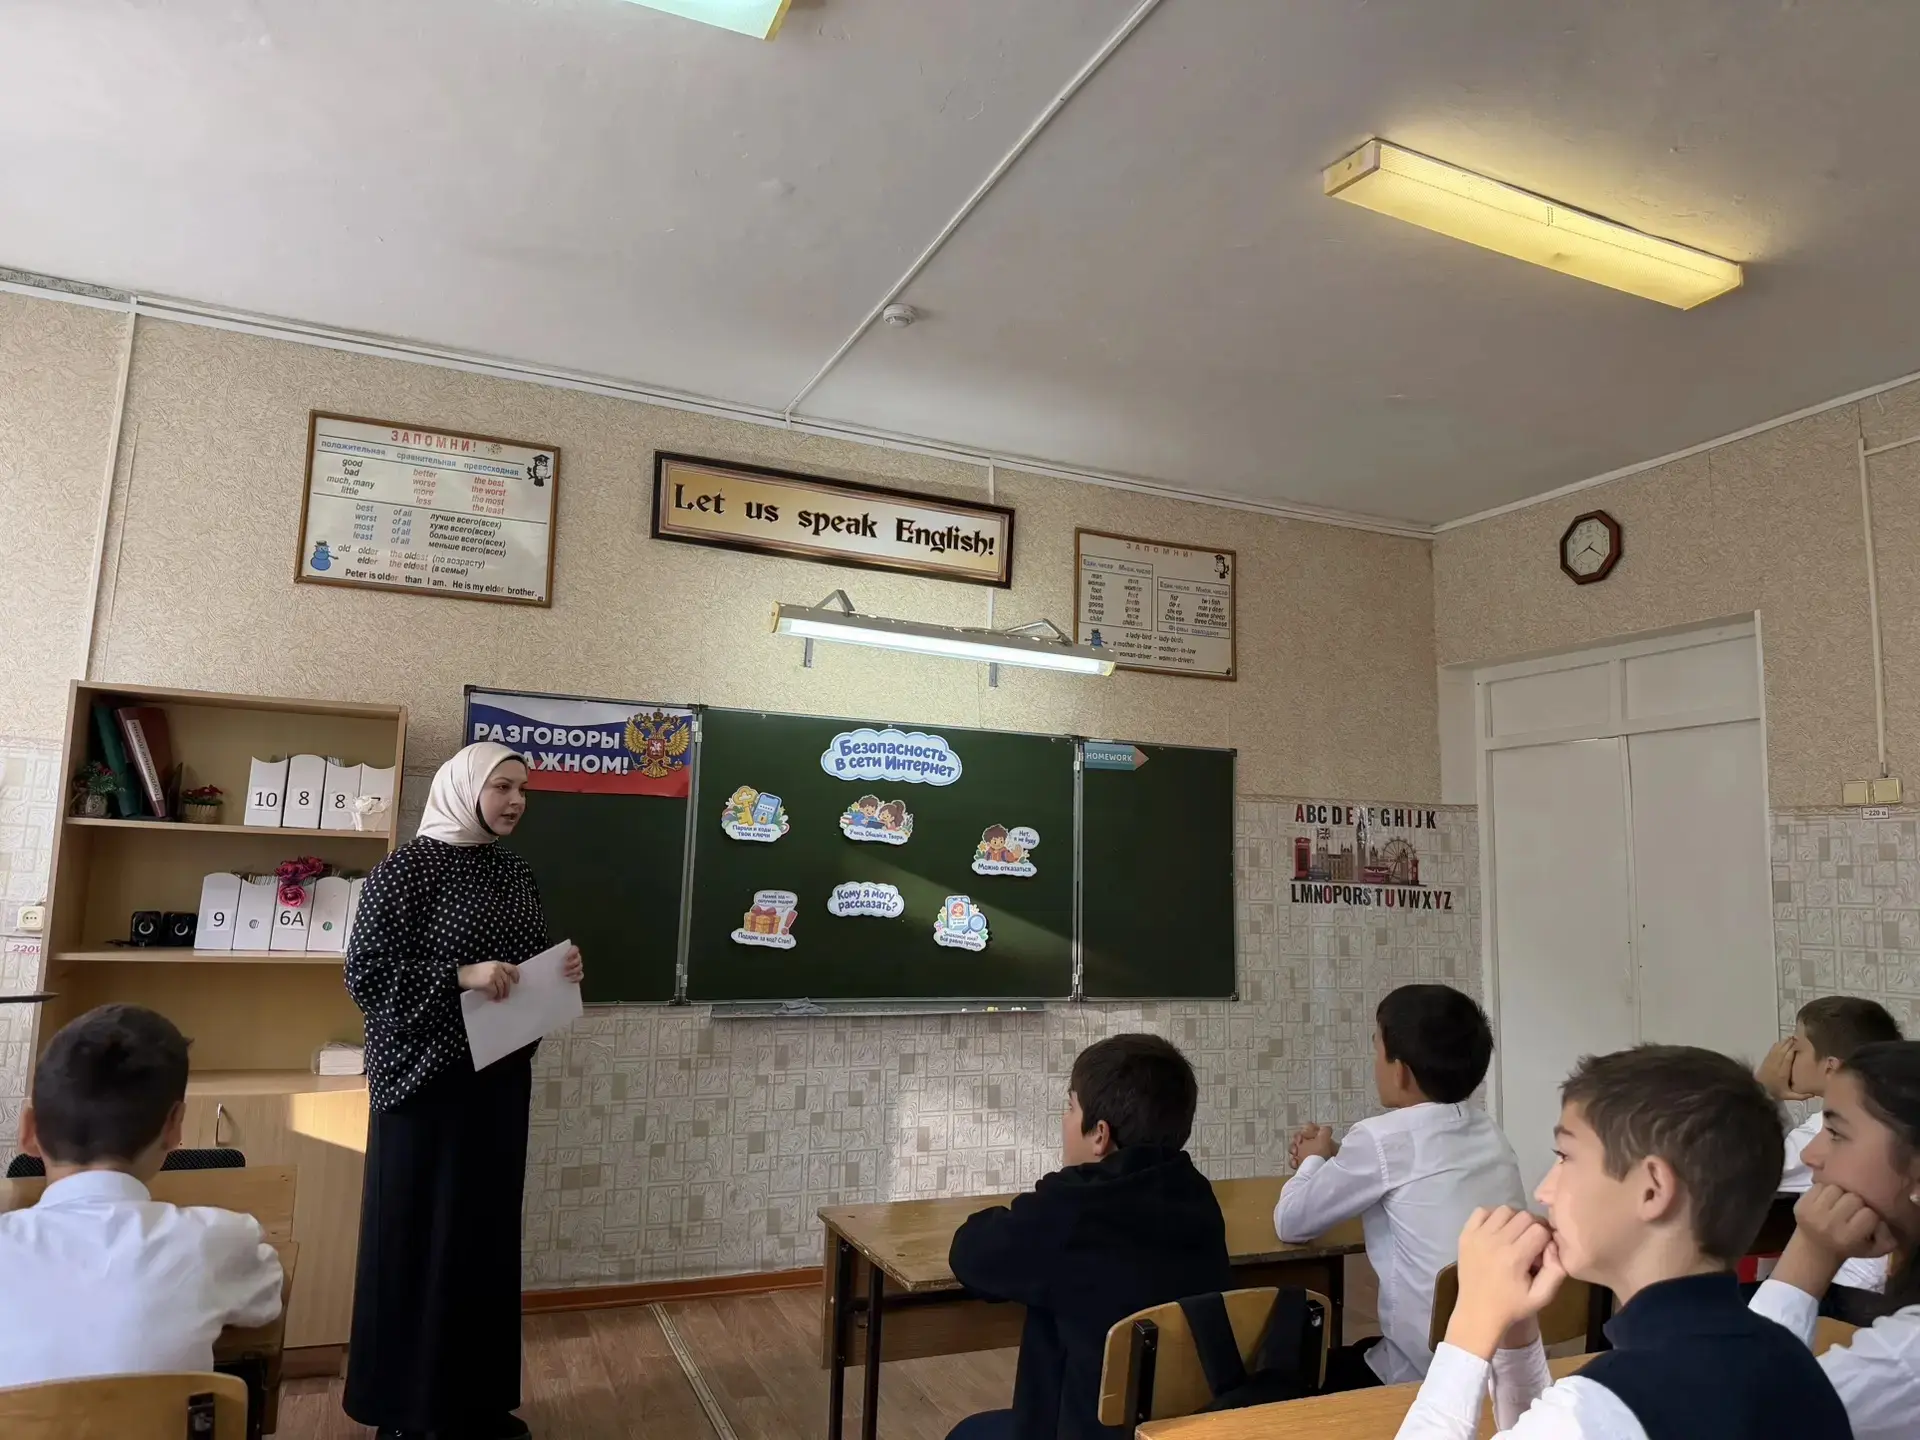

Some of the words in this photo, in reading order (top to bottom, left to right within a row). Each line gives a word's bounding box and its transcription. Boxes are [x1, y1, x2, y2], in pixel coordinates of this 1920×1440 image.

[391, 430, 476, 452] ЗАПОМНИ!
[321, 440, 386, 455] положительная
[342, 459, 363, 467] good
[396, 452, 456, 468] сравнительная
[344, 467, 360, 476] bad
[412, 468, 438, 479] better
[464, 461, 519, 476] превосходная
[326, 475, 351, 485] much,
[352, 480, 375, 489] many
[412, 479, 436, 488] worse
[474, 476, 487, 485] the
[487, 478, 505, 487] best
[340, 486, 359, 495] little
[413, 488, 434, 496] more
[471, 485, 484, 495] the
[484, 487, 506, 496] worst
[415, 496, 432, 506] less
[471, 495, 484, 504] the
[484, 497, 505, 506] most
[356, 503, 374, 512] best
[472, 504, 485, 512] the
[485, 505, 505, 515] least
[355, 513, 377, 522] worst
[430, 513, 456, 522] лучше
[456, 517, 502, 529] всего(всех)
[674, 483, 726, 515] Let
[745, 501, 780, 522] us
[798, 512, 878, 536] speak
[895, 517, 995, 557] English!
[354, 523, 374, 531] most
[391, 527, 400, 535] of
[400, 528, 411, 536] all
[429, 522, 449, 531] хуже
[450, 526, 495, 538] всего(всех)
[353, 531, 373, 541] least
[390, 536, 399, 544] of
[399, 537, 410, 545] all
[429, 530, 460, 541] больше
[460, 536, 506, 548] всего(всех)
[337, 544, 351, 552] old
[358, 546, 379, 556] older
[428, 541, 461, 551] меньше
[461, 545, 507, 558] всего(всех)
[357, 556, 378, 566] elder
[389, 549, 403, 558] the
[404, 551, 429, 562] oldest
[432, 554, 446, 564] (по
[446, 557, 485, 568] возрасту)
[388, 558, 403, 568] the
[403, 562, 428, 572] eldest
[431, 564, 440, 573] (в
[440, 566, 469, 577] семье)
[345, 568, 368, 578] Peter
[368, 570, 376, 580] is
[377, 572, 399, 582] older
[405, 574, 422, 585] than
[427, 577, 430, 585] I
[432, 579, 447, 587] am.
[452, 580, 463, 589] He
[464, 582, 471, 590] is
[485, 585, 504, 593] elder
[507, 586, 537, 597] brother.
[473, 723, 620, 749] РАЗГОВОРЫ
[839, 739, 948, 762] Безопасность
[524, 750, 629, 775] АЖНОМ!
[1086, 752, 1133, 762] HOMEWORK
[848, 755, 882, 769] сети
[884, 755, 956, 777] Интернет
[254, 791, 278, 807] 10
[298, 791, 310, 806] 8
[334, 794, 346, 809] 8
[978, 863, 999, 871] Можно
[1000, 865, 1032, 873] отказаться
[837, 889, 861, 900] Кому
[871, 890, 895, 903] могу
[838, 900, 898, 912] рассказать?
[213, 911, 225, 928] 9
[737, 932, 759, 941] Подарок
